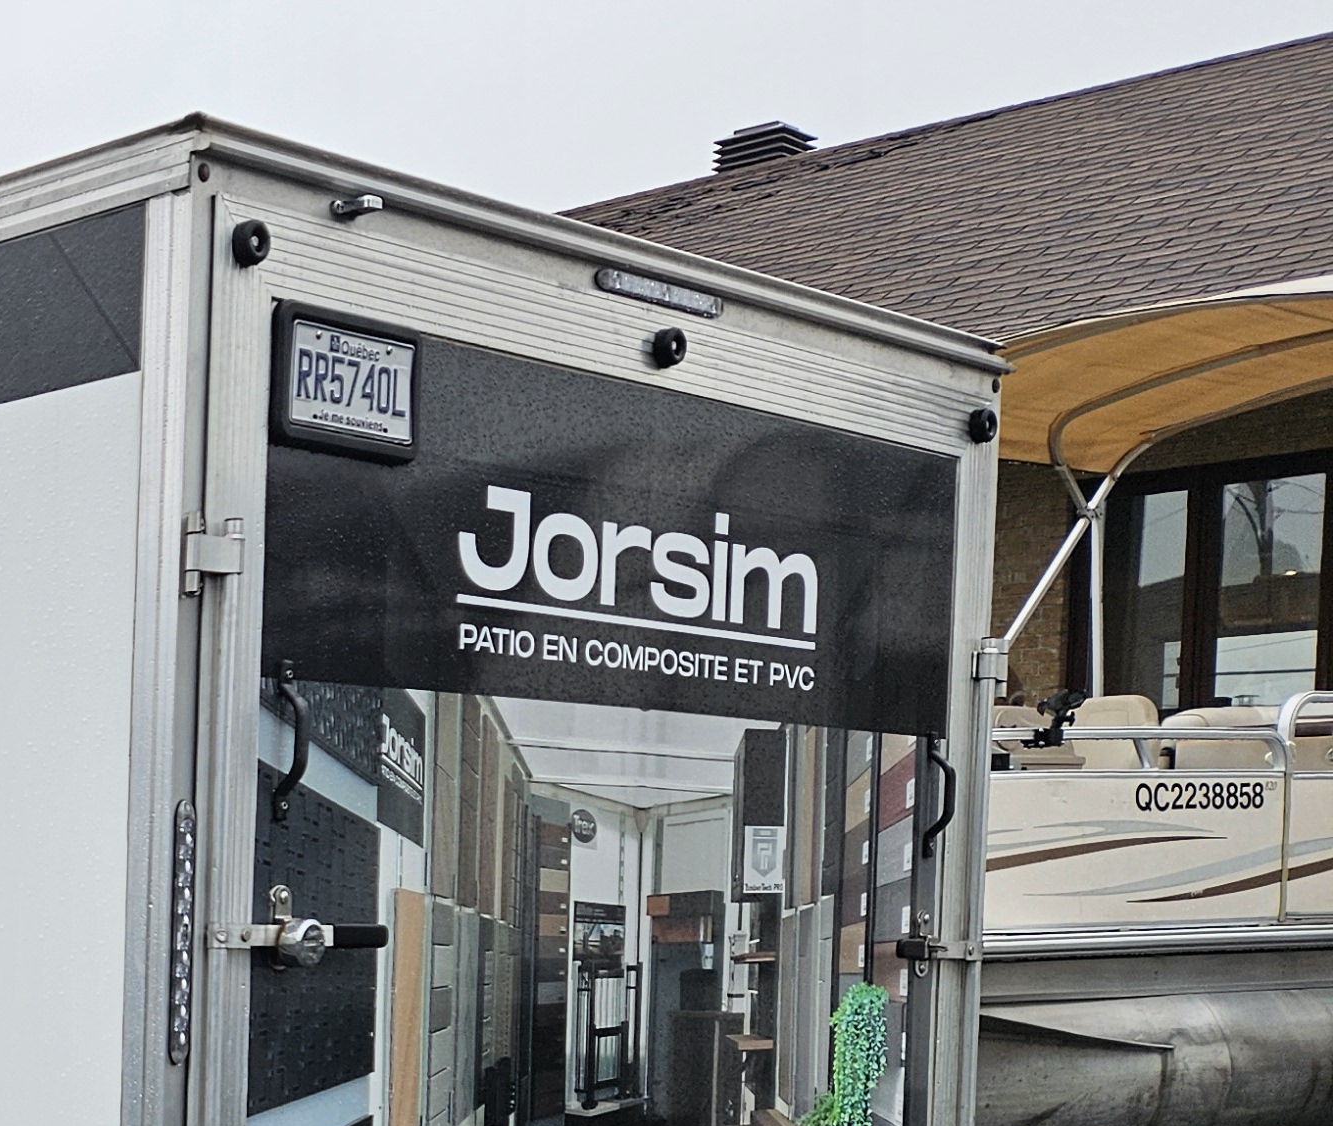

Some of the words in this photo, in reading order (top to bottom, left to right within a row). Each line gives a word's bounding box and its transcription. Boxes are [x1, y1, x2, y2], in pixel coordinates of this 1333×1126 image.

[341, 341, 380, 362] Québec
[296, 347, 406, 417] RR5740L
[331, 413, 344, 424] me
[346, 416, 383, 432] souviens
[458, 485, 818, 634] Jorsim
[459, 623, 534, 658] PATIO
[543, 634, 577, 662] EN
[585, 640, 728, 681] COMPOSITE
[734, 658, 763, 685] ET
[769, 663, 815, 691] PVC
[1135, 782, 1264, 812] QC2238858
